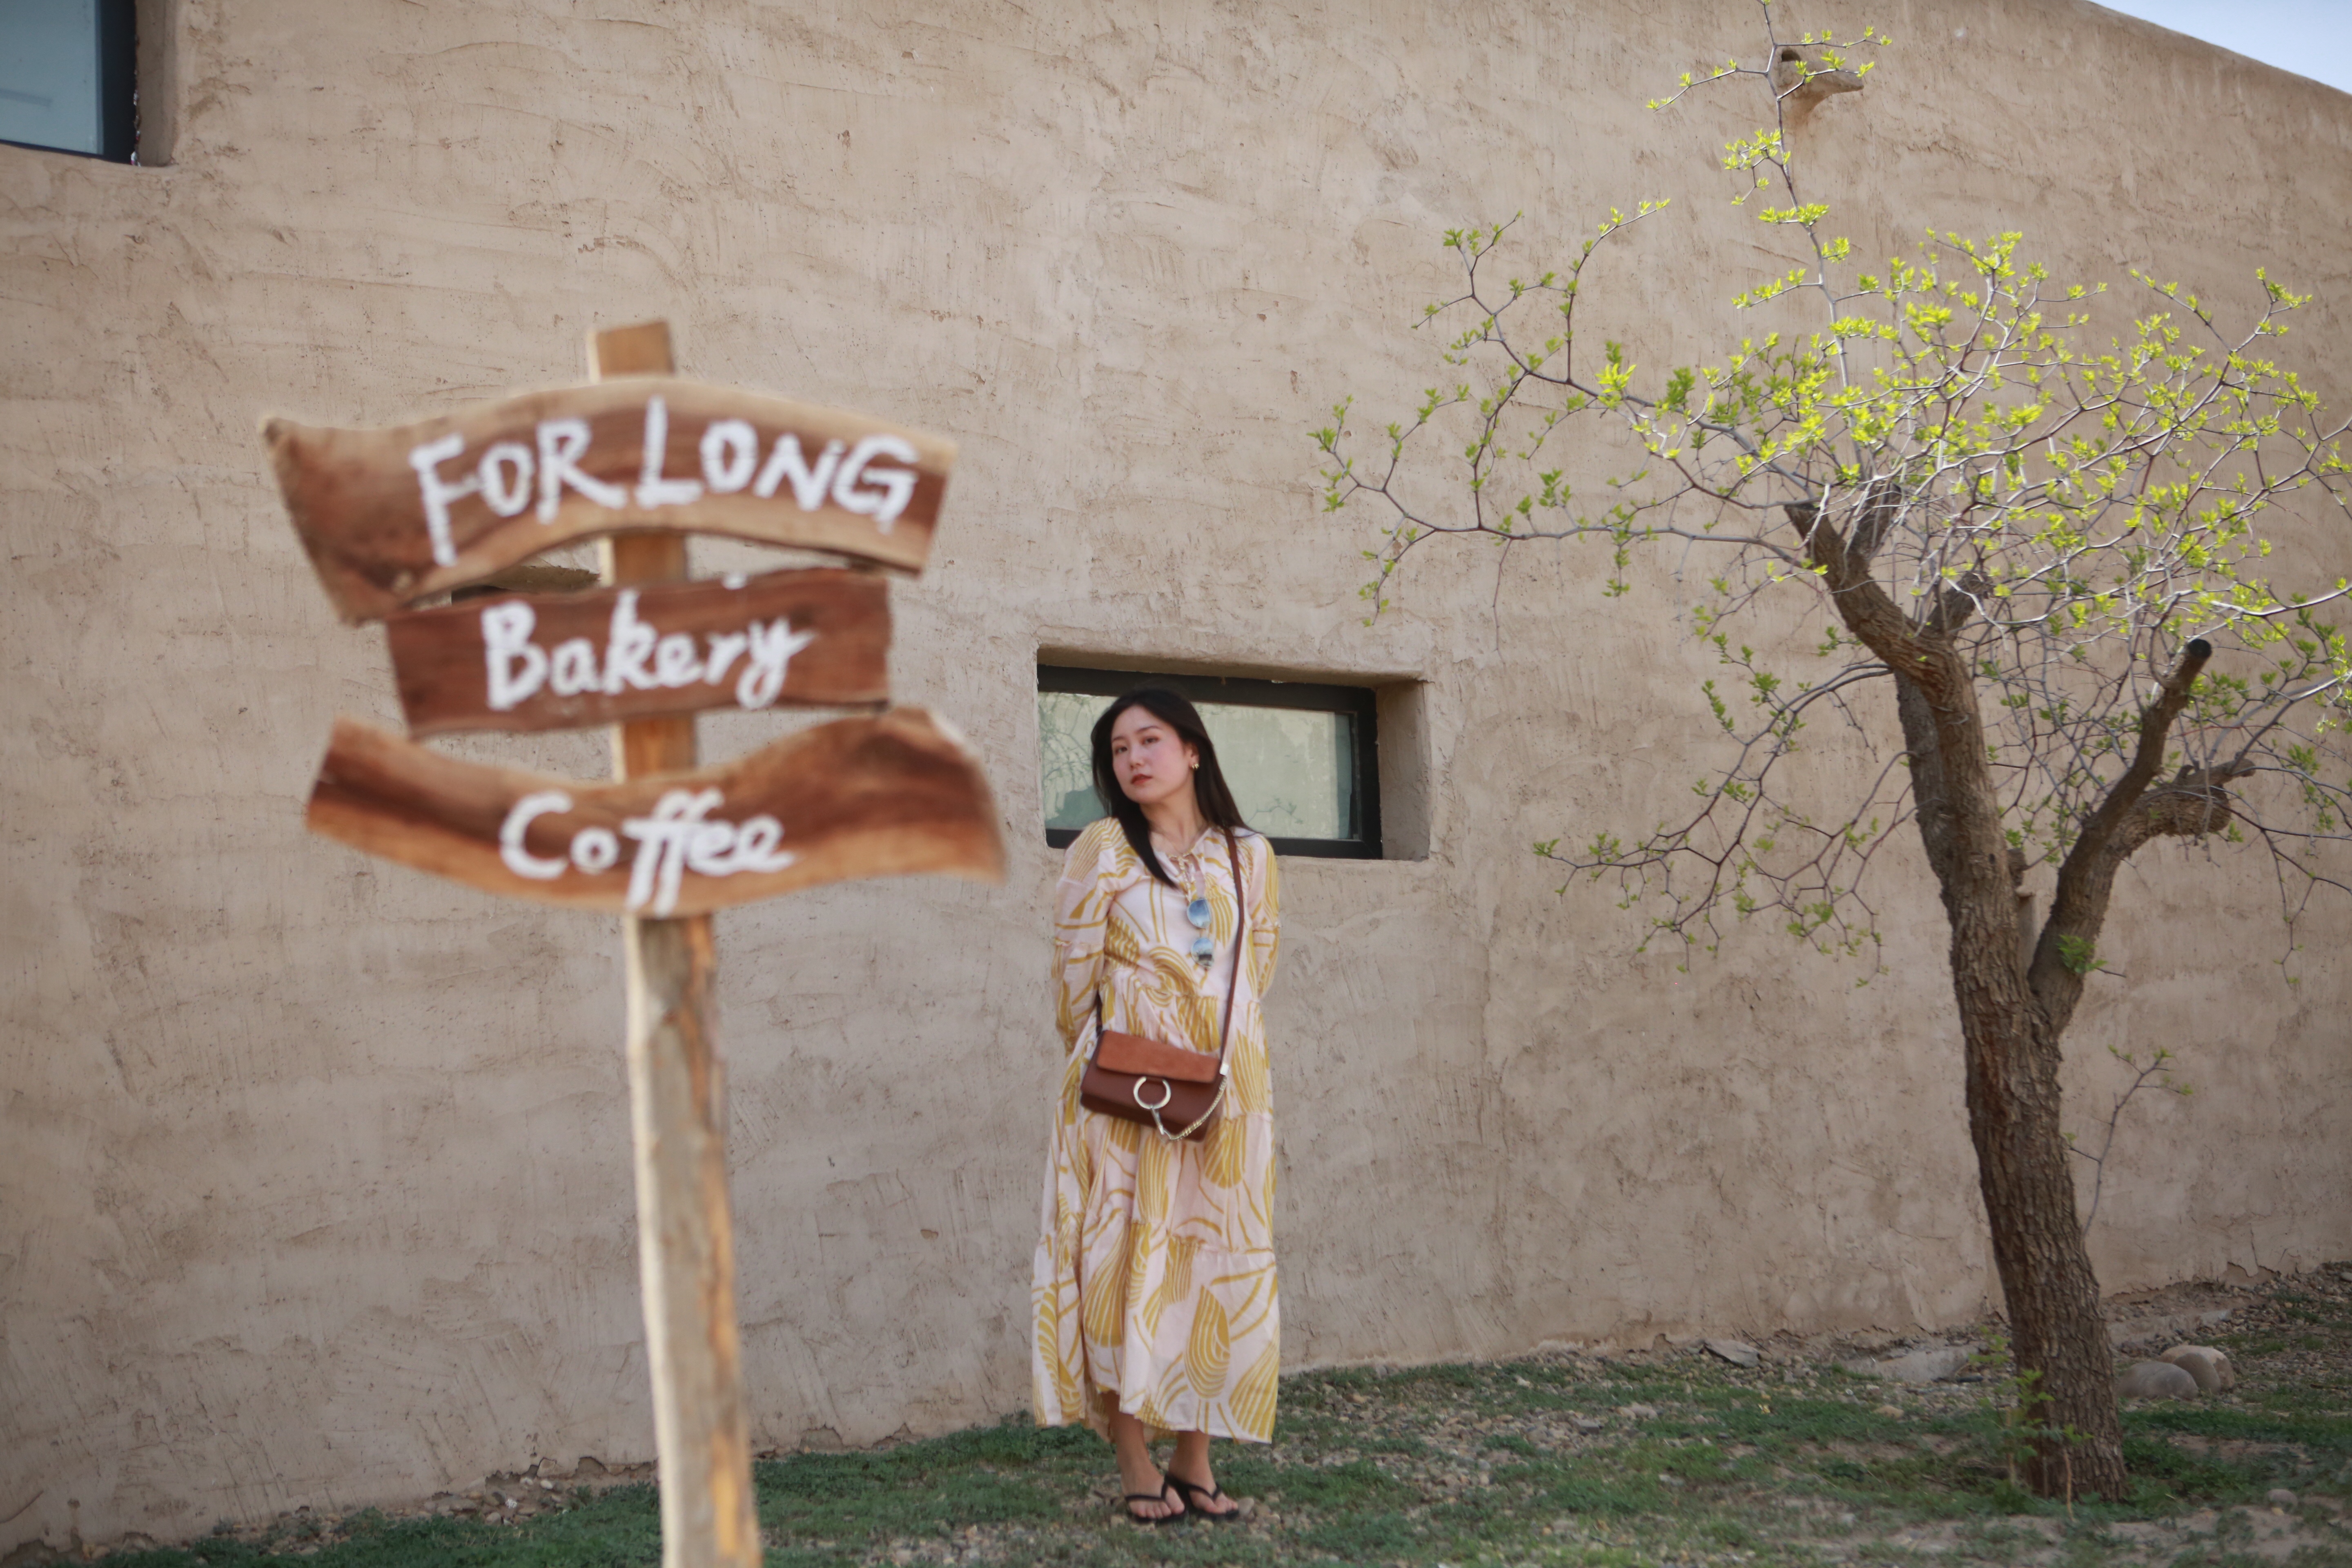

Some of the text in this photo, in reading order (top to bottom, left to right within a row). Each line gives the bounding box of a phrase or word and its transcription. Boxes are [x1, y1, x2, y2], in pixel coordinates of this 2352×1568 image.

[410, 397, 919, 567] FOR LONG
[481, 589, 814, 709] Bakery
[499, 789, 796, 916] Coffee
